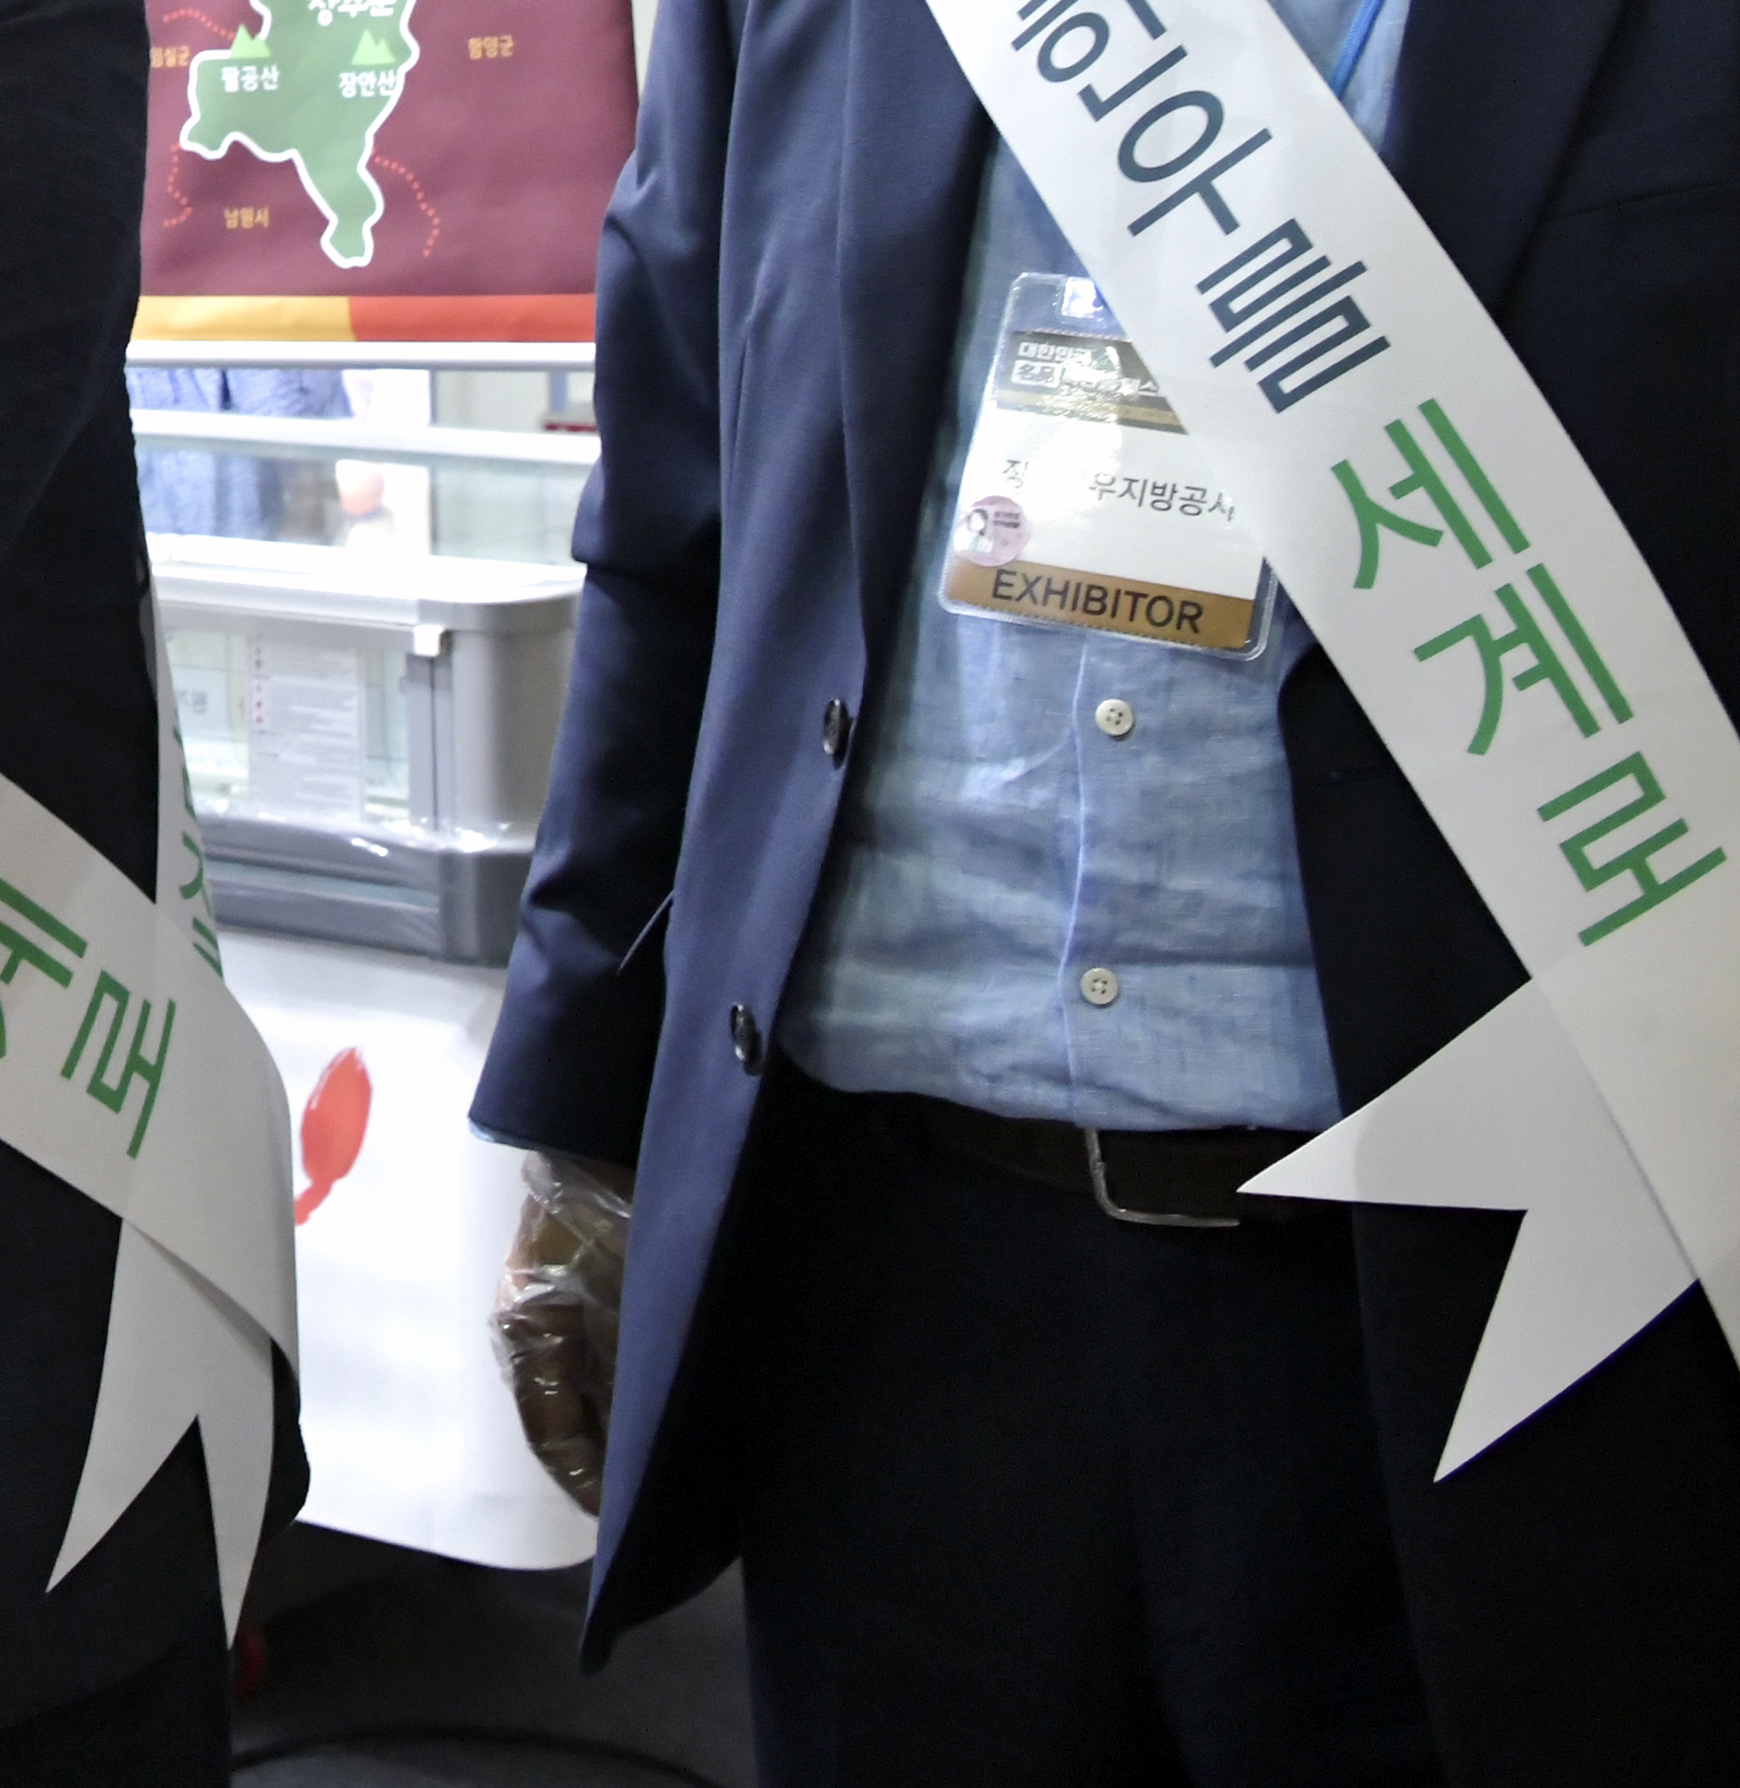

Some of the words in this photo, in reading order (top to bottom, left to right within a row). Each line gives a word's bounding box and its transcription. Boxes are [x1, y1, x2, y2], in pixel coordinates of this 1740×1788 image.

[338, 69, 398, 99] 장안산
[1002, 459, 1235, 522] 장우지방공사
[991, 568, 1205, 635] EXHIBITOR
[1331, 398, 1727, 947] 세계로
